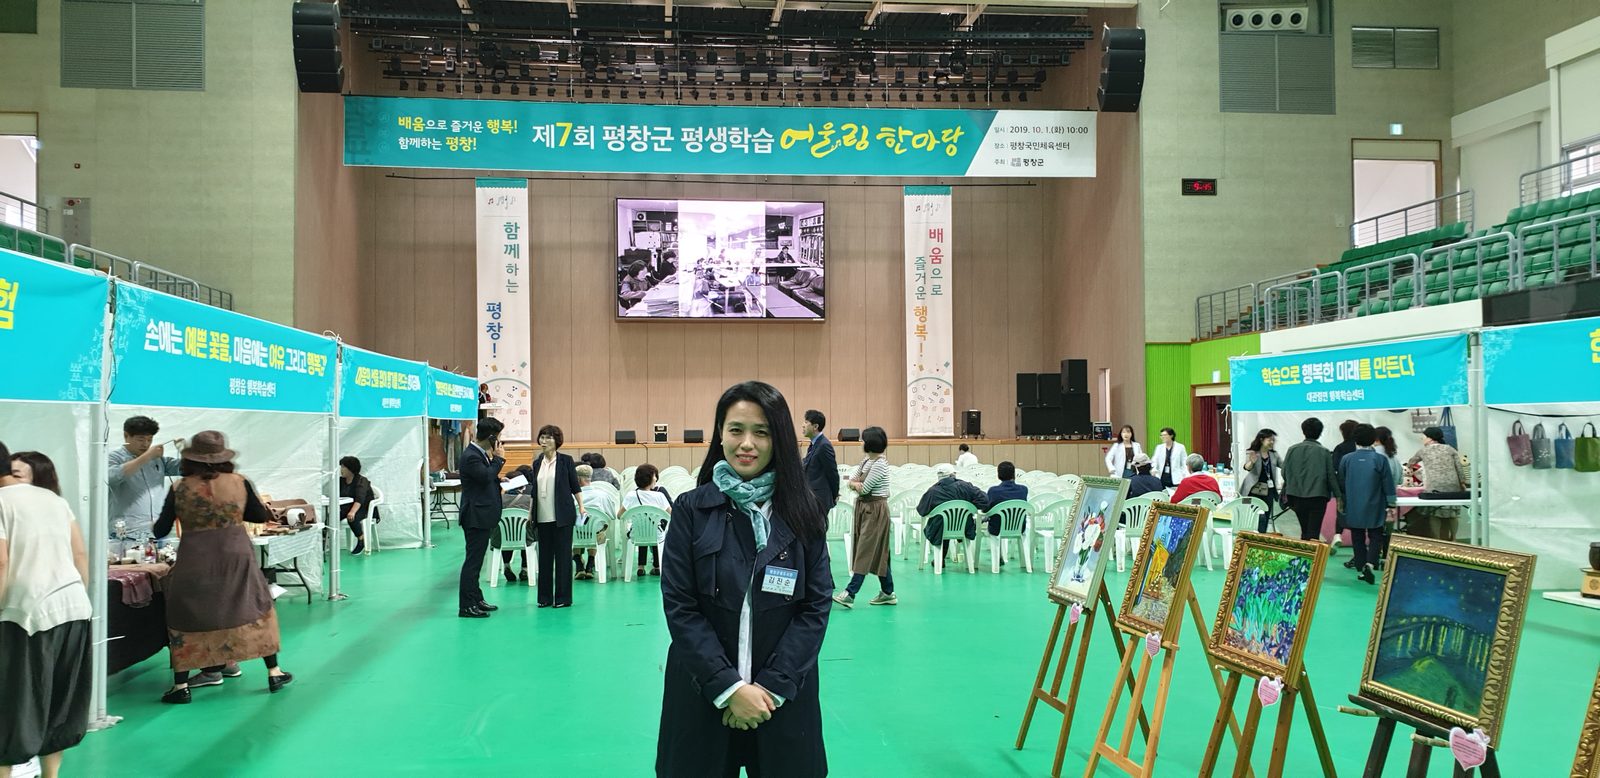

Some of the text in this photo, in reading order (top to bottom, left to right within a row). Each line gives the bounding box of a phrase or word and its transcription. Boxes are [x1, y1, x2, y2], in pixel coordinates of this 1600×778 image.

[398, 116, 518, 134] 배움으로 즐거운 행복!
[532, 122, 595, 150] 제7회
[602, 125, 675, 152] 평창군
[680, 126, 775, 154] 평생학습
[875, 125, 965, 156] 한마당
[1009, 126, 1030, 134] 2019.
[1032, 126, 1044, 134] 10.
[1067, 126, 1089, 134] 10:00
[398, 137, 477, 152] 함께하는 평창!
[1009, 141, 1070, 150] 평창국민체육센터
[1023, 158, 1044, 167] 평창군
[504, 221, 520, 294] 함께하는
[929, 228, 944, 296] 배움으로
[914, 256, 927, 301] 즐거운
[144, 318, 183, 355] 손에는
[185, 326, 207, 359] 예쁜
[233, 336, 268, 369] 마음에는
[285, 347, 307, 374] 그리고
[486, 302, 503, 358] 평창!
[913, 304, 929, 358] 행복!
[1261, 354, 1415, 386] 학습으로 행복한 미래를 만든다
